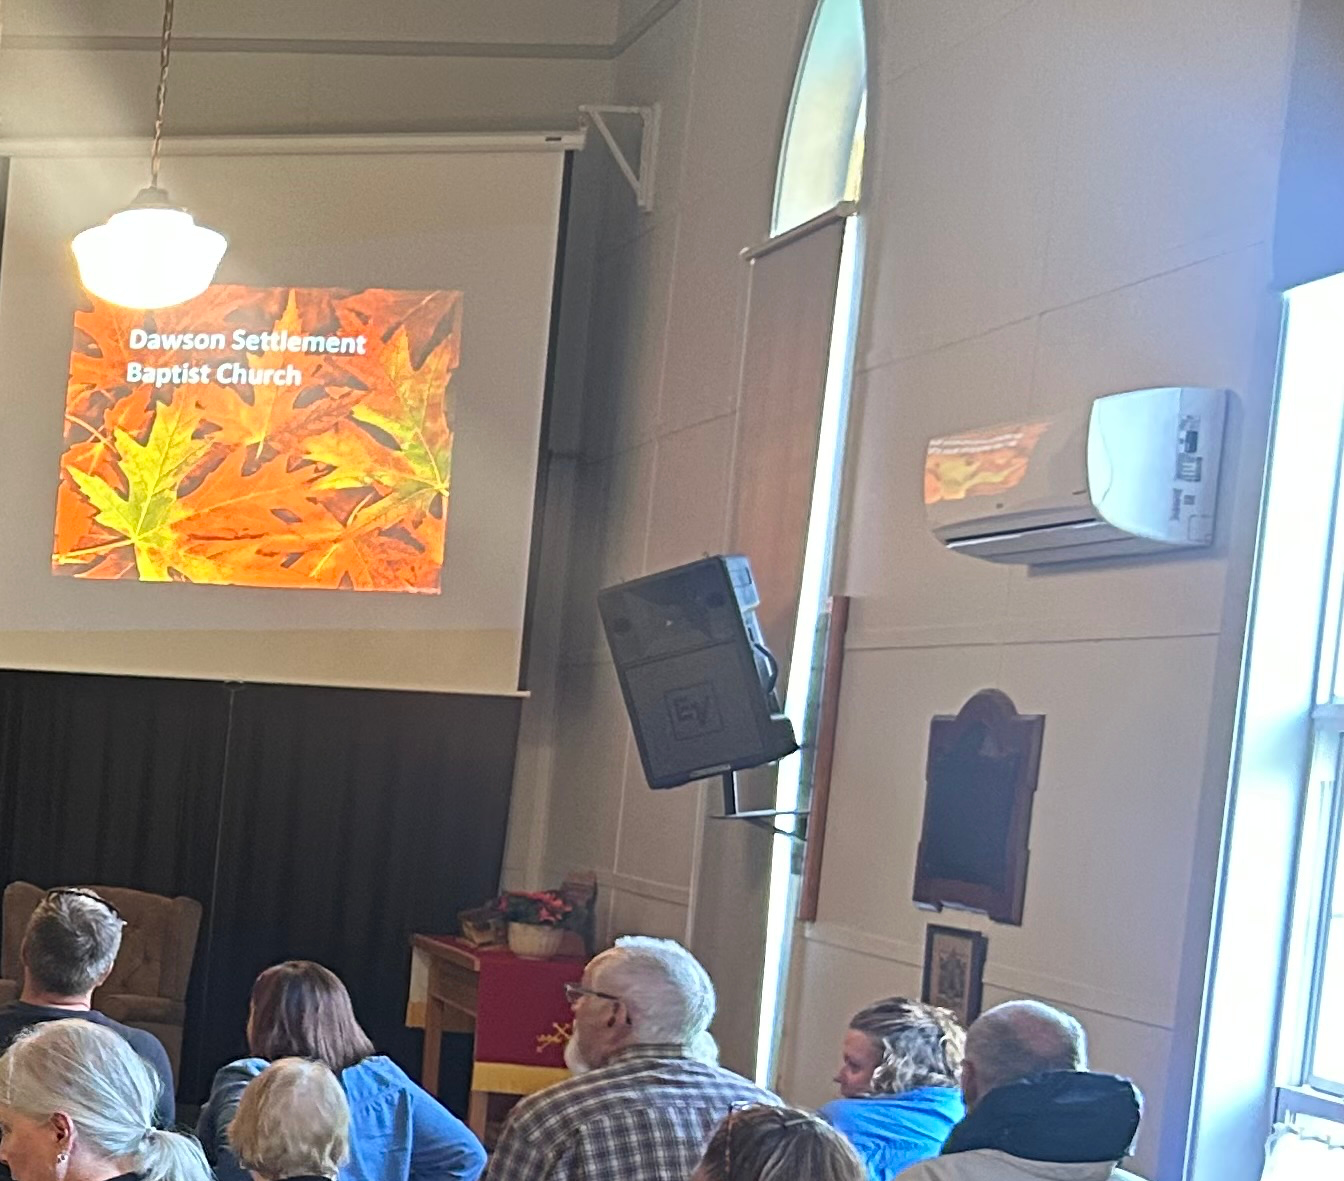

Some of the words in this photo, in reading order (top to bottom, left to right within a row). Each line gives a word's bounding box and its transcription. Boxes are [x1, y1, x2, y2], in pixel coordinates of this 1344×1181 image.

[129, 329, 226, 351] Dawson
[232, 329, 367, 354] Settlement
[126, 362, 211, 388] Baptist
[216, 362, 302, 386] Church
